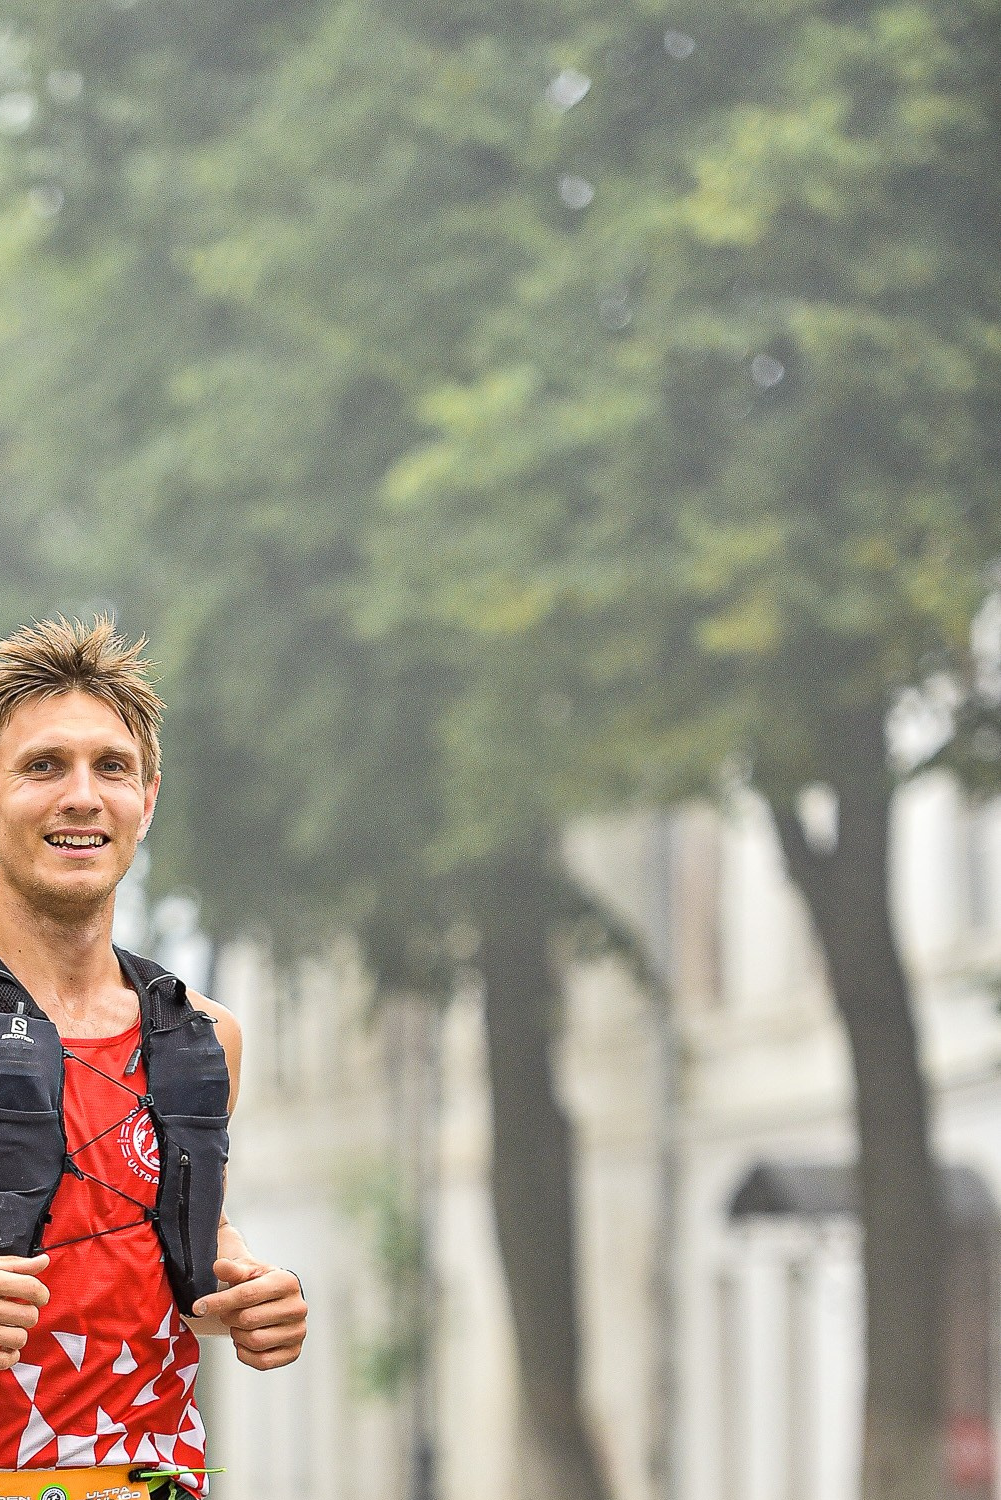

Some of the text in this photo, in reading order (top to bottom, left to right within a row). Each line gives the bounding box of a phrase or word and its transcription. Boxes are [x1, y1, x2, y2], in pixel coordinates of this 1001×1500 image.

[127, 1158, 159, 1184] ULTRA
[86, 1486, 130, 1499] ULTRA
[117, 1491, 141, 1500] 100
